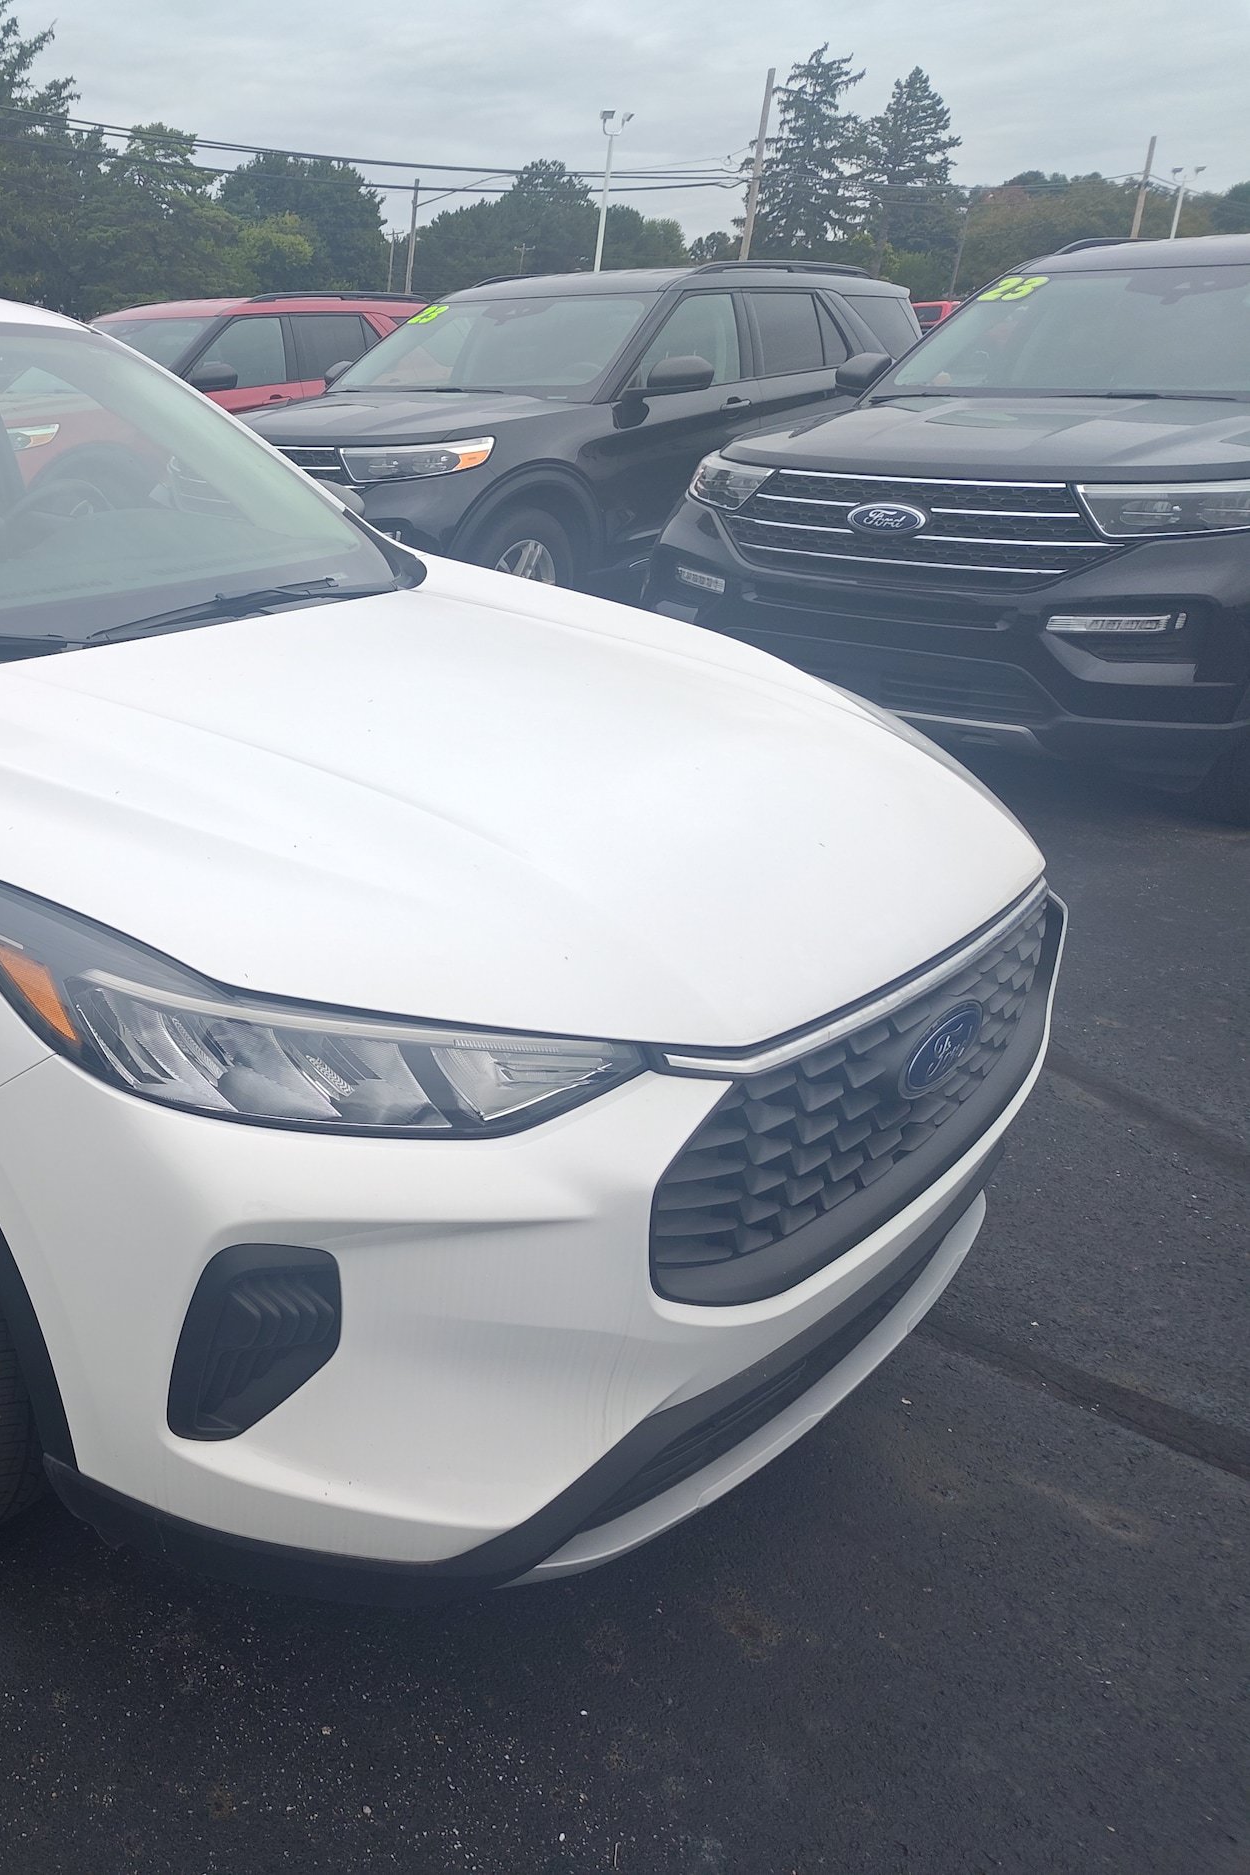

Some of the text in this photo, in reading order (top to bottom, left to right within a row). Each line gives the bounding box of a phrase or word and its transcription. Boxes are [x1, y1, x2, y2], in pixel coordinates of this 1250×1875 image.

[977, 276, 1050, 301] 23
[406, 305, 449, 324] 23
[862, 508, 907, 529] Ford
